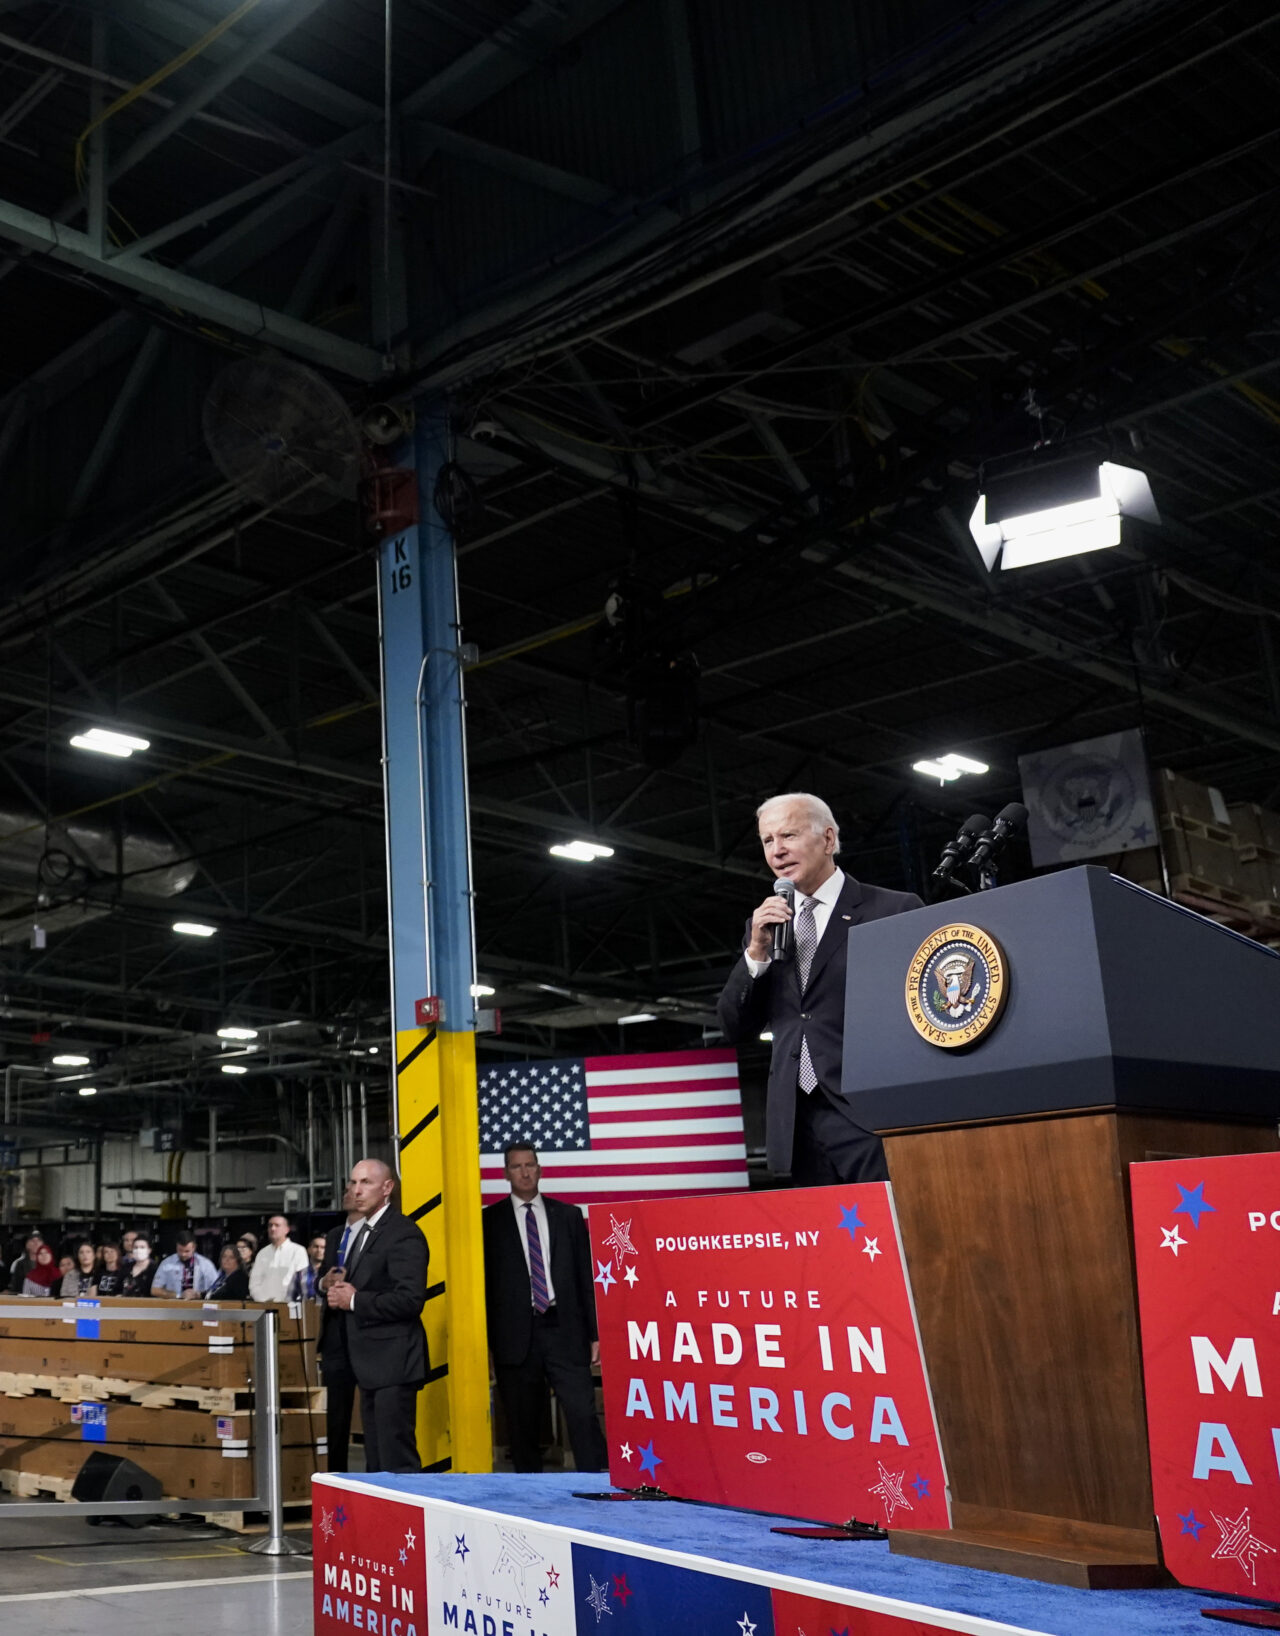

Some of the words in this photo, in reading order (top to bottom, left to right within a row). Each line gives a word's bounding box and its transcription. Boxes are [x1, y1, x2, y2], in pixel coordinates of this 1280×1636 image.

[394, 537, 407, 564] K
[391, 564, 412, 594] 16
[951, 929, 961, 938] OF
[961, 929, 975, 940] THE
[909, 930, 949, 991] PRESIDENT
[976, 936, 1000, 984] UNITED
[910, 996, 919, 1013] THE
[964, 995, 997, 1039] STATES
[922, 1019, 947, 1043] SEAL
[655, 1232, 789, 1251] POUGHKEEPSIE,
[795, 1230, 820, 1247] NY
[665, 1291, 677, 1307] A
[697, 1290, 821, 1309] FUTURE
[627, 1320, 786, 1368] MADE
[818, 1325, 887, 1374] IN
[625, 1378, 910, 1446] AMERICA
[339, 1551, 345, 1562] A
[351, 1555, 394, 1577] FUTURE
[324, 1563, 381, 1603] MADE
[391, 1584, 414, 1614] IN
[461, 1588, 467, 1599] A
[477, 1593, 532, 1619] FUTURE
